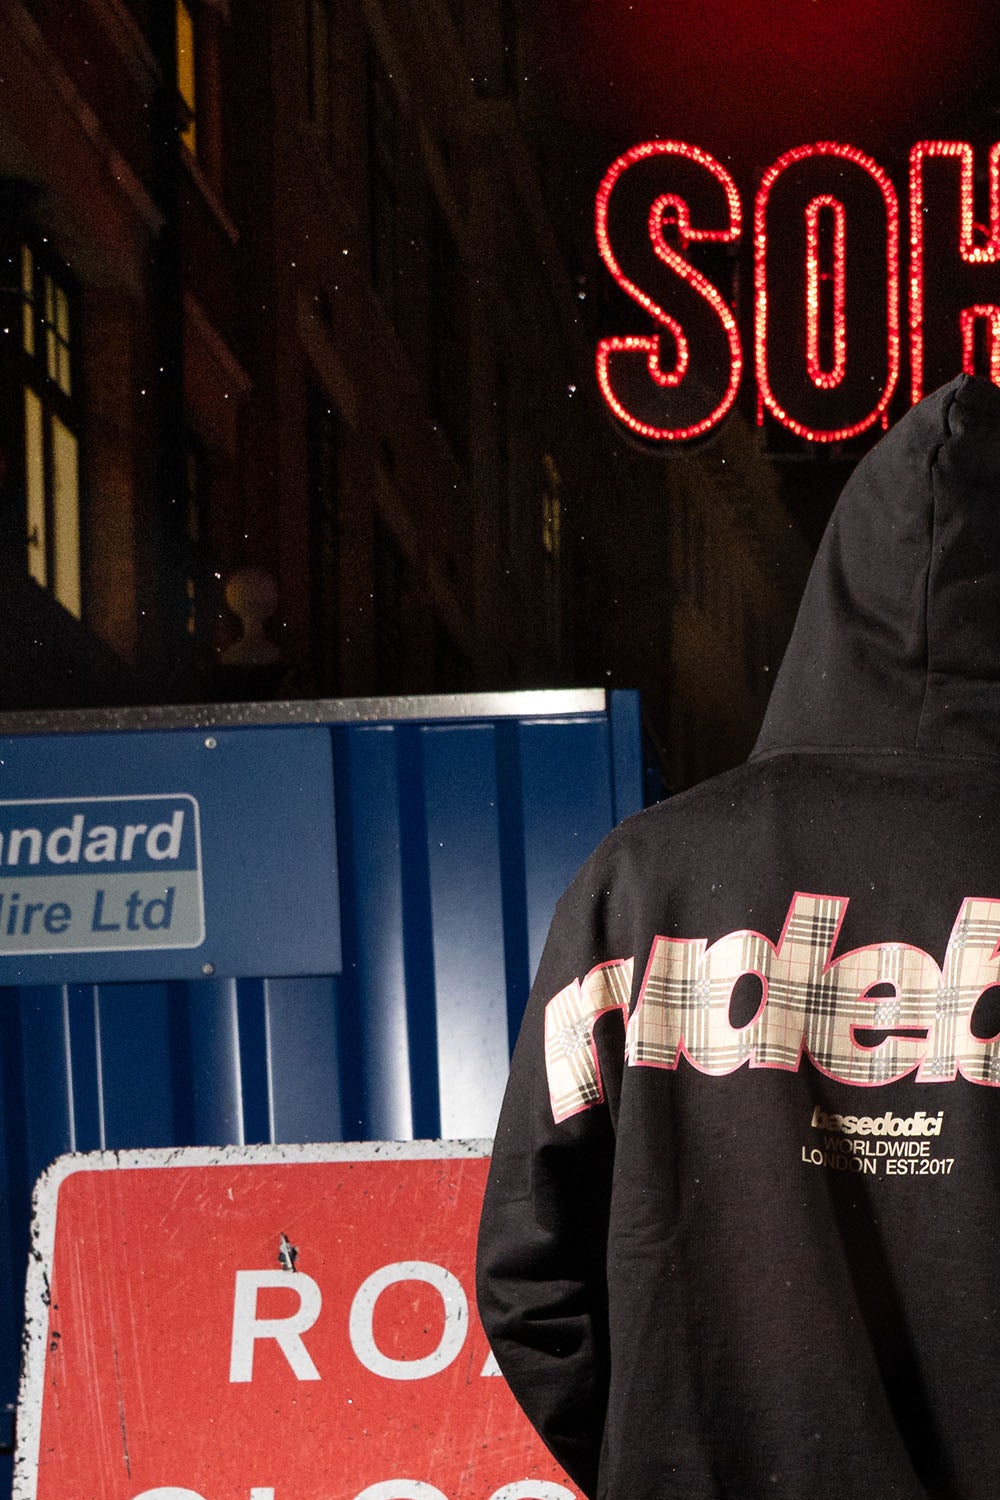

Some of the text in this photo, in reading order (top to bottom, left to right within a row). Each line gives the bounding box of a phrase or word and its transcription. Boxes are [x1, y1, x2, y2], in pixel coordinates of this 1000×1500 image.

[0, 810, 185, 867] ndard
[0, 886, 176, 936] ire Ltd
[811, 1105, 944, 1137] basedodici
[801, 1146, 955, 1176] LONDON EST.2017
[824, 1136, 931, 1157] WORLDWIDE
[228, 1260, 504, 1383] RO
